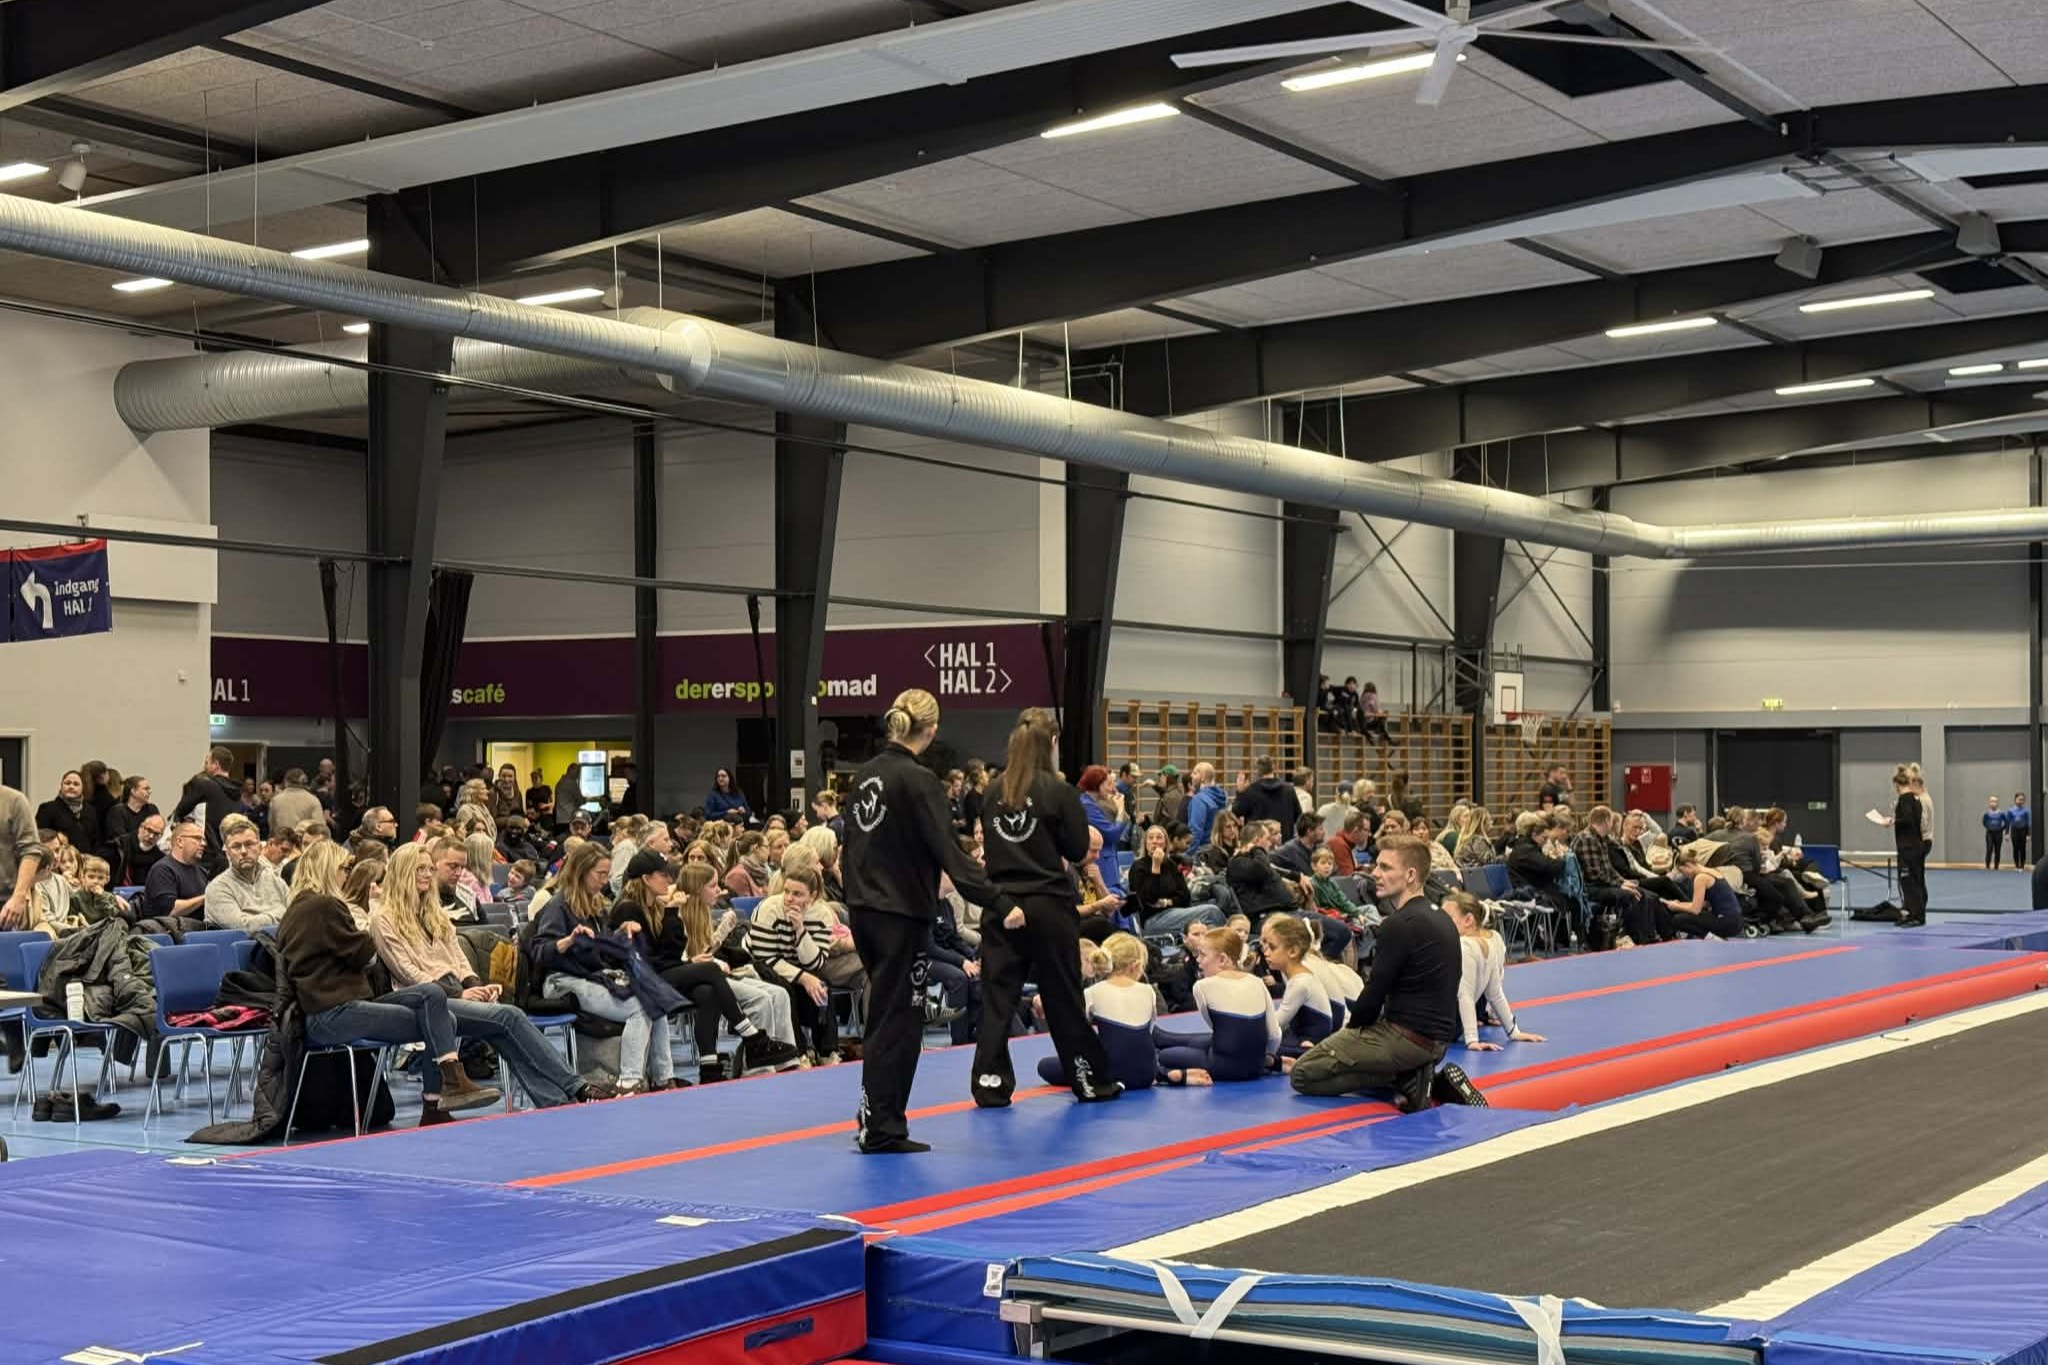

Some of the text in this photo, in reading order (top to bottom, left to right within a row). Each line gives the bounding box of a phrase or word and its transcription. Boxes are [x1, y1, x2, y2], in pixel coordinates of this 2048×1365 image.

[54, 578, 100, 597] Indgang
[63, 597, 92, 616] HAL 1
[940, 641, 996, 668] HAL 1
[210, 678, 250, 702] AL 1
[940, 668, 996, 694] HAL 2
[450, 683, 505, 704] scafé
